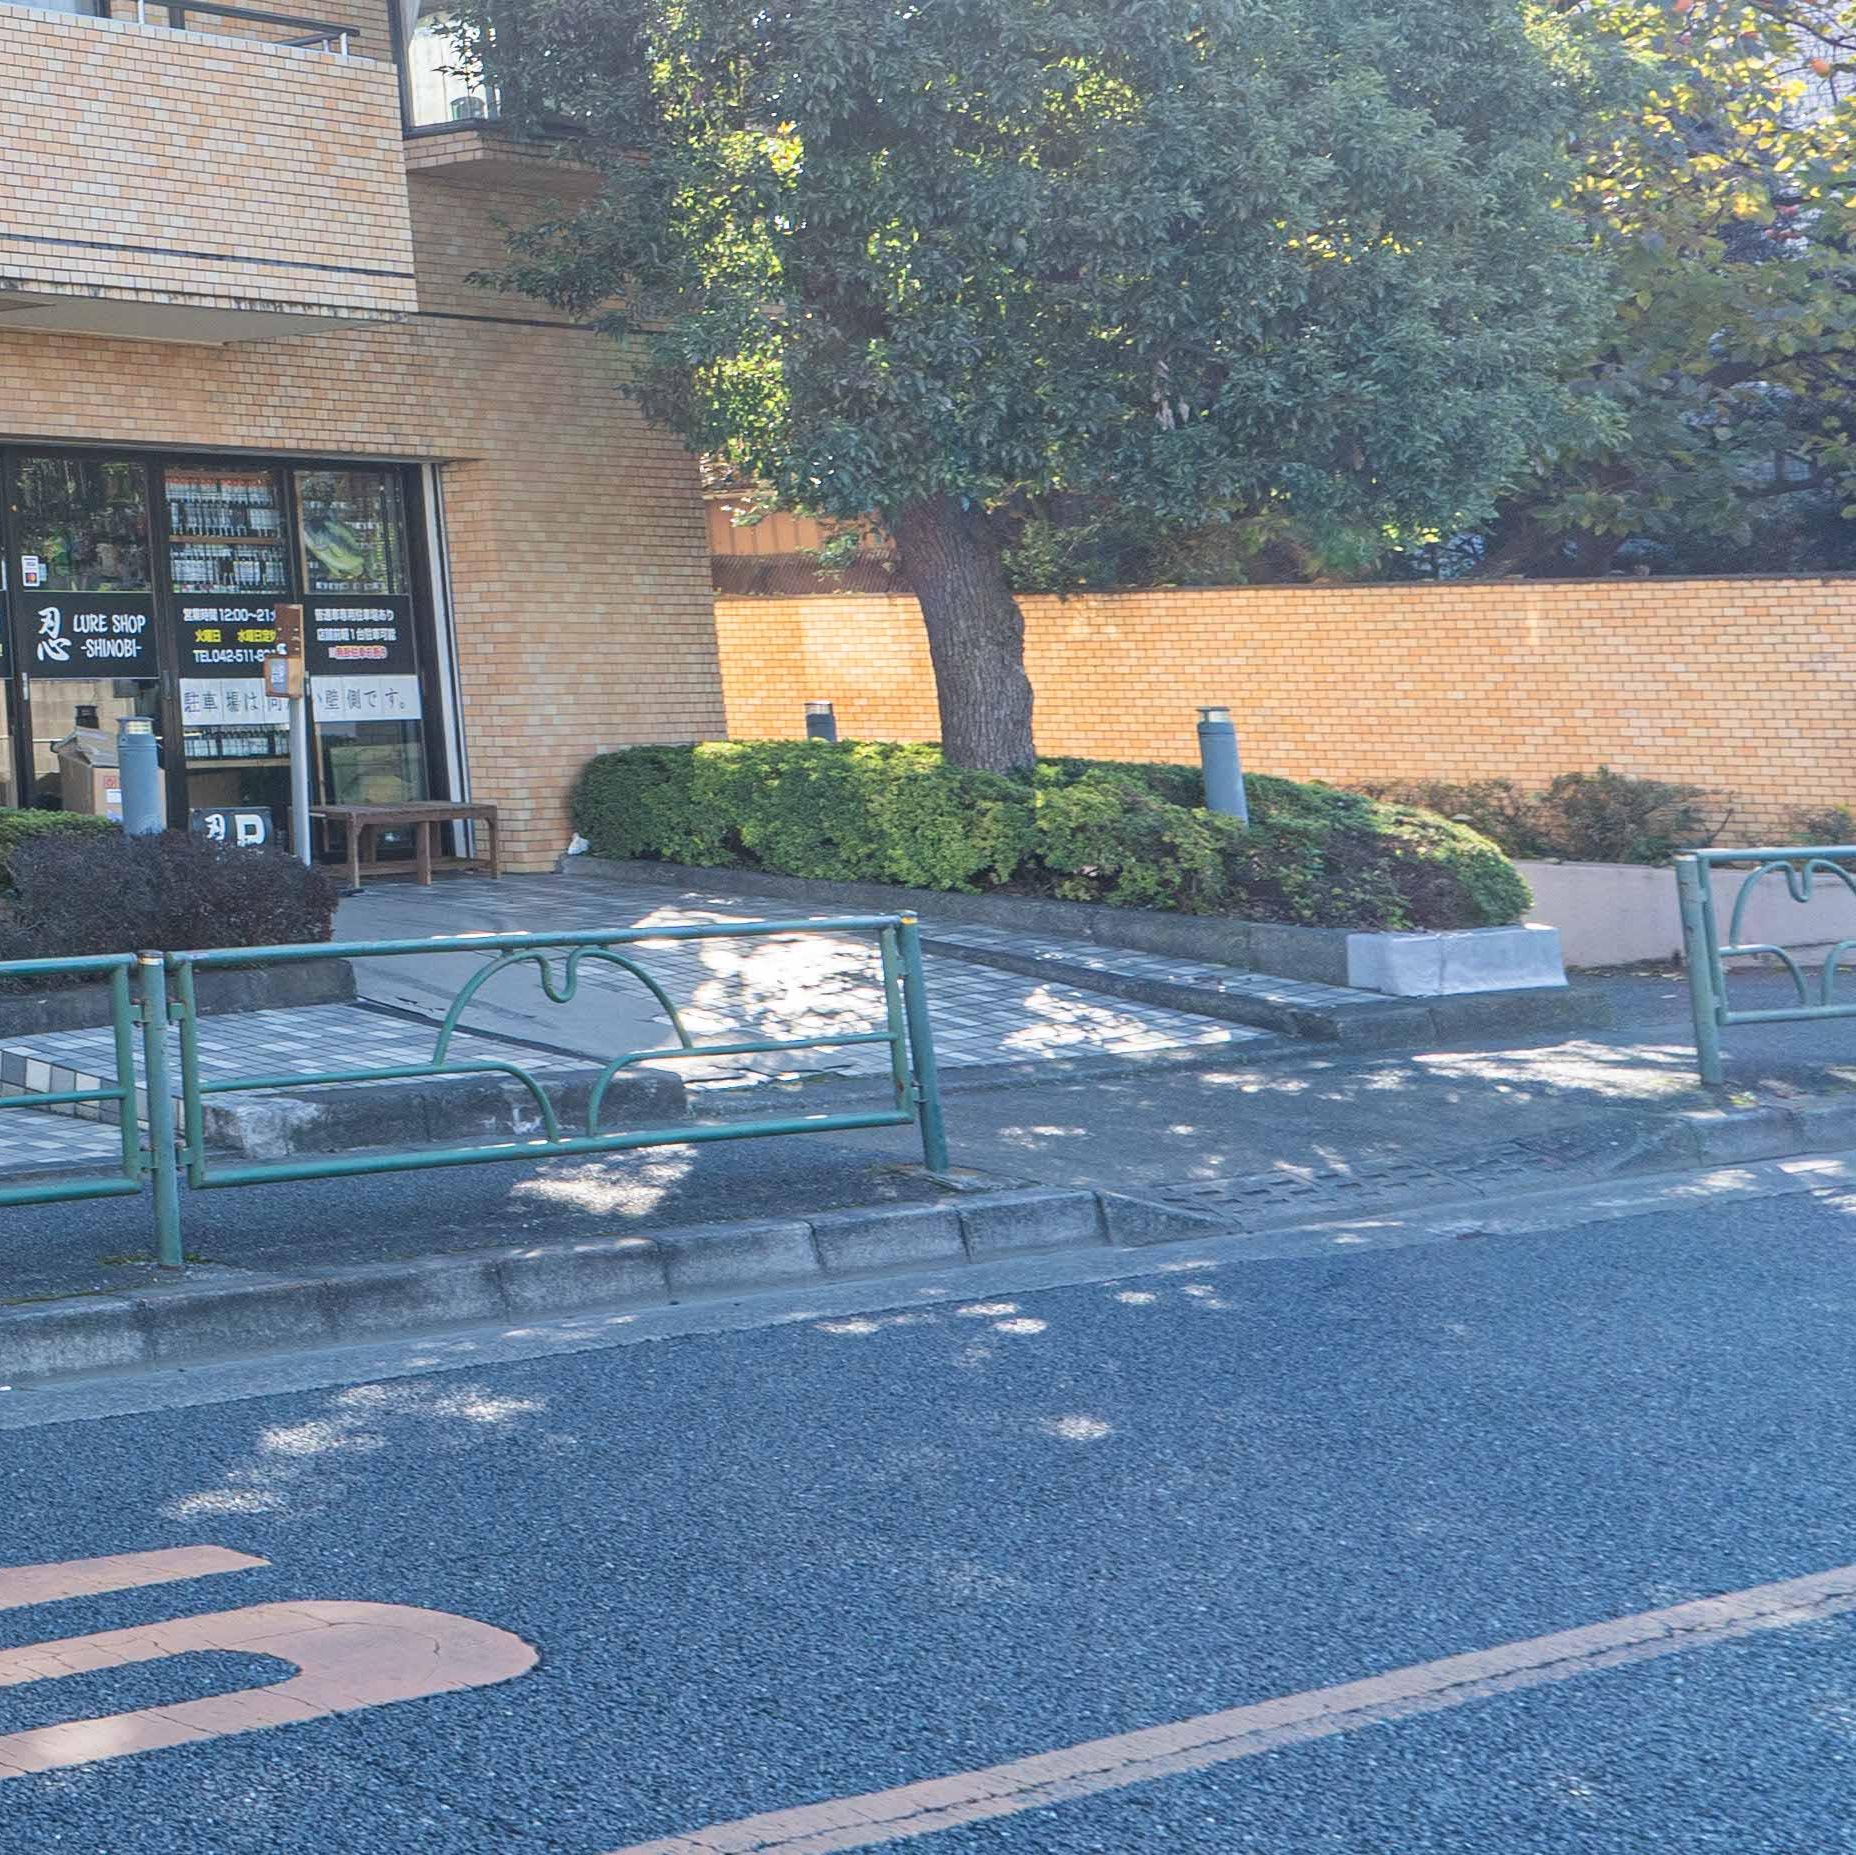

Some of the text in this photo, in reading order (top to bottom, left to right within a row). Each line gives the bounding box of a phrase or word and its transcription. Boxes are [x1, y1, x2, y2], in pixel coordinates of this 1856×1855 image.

[37, 607, 72, 661] 忍
[73, 614, 146, 634] LURE SHOP
